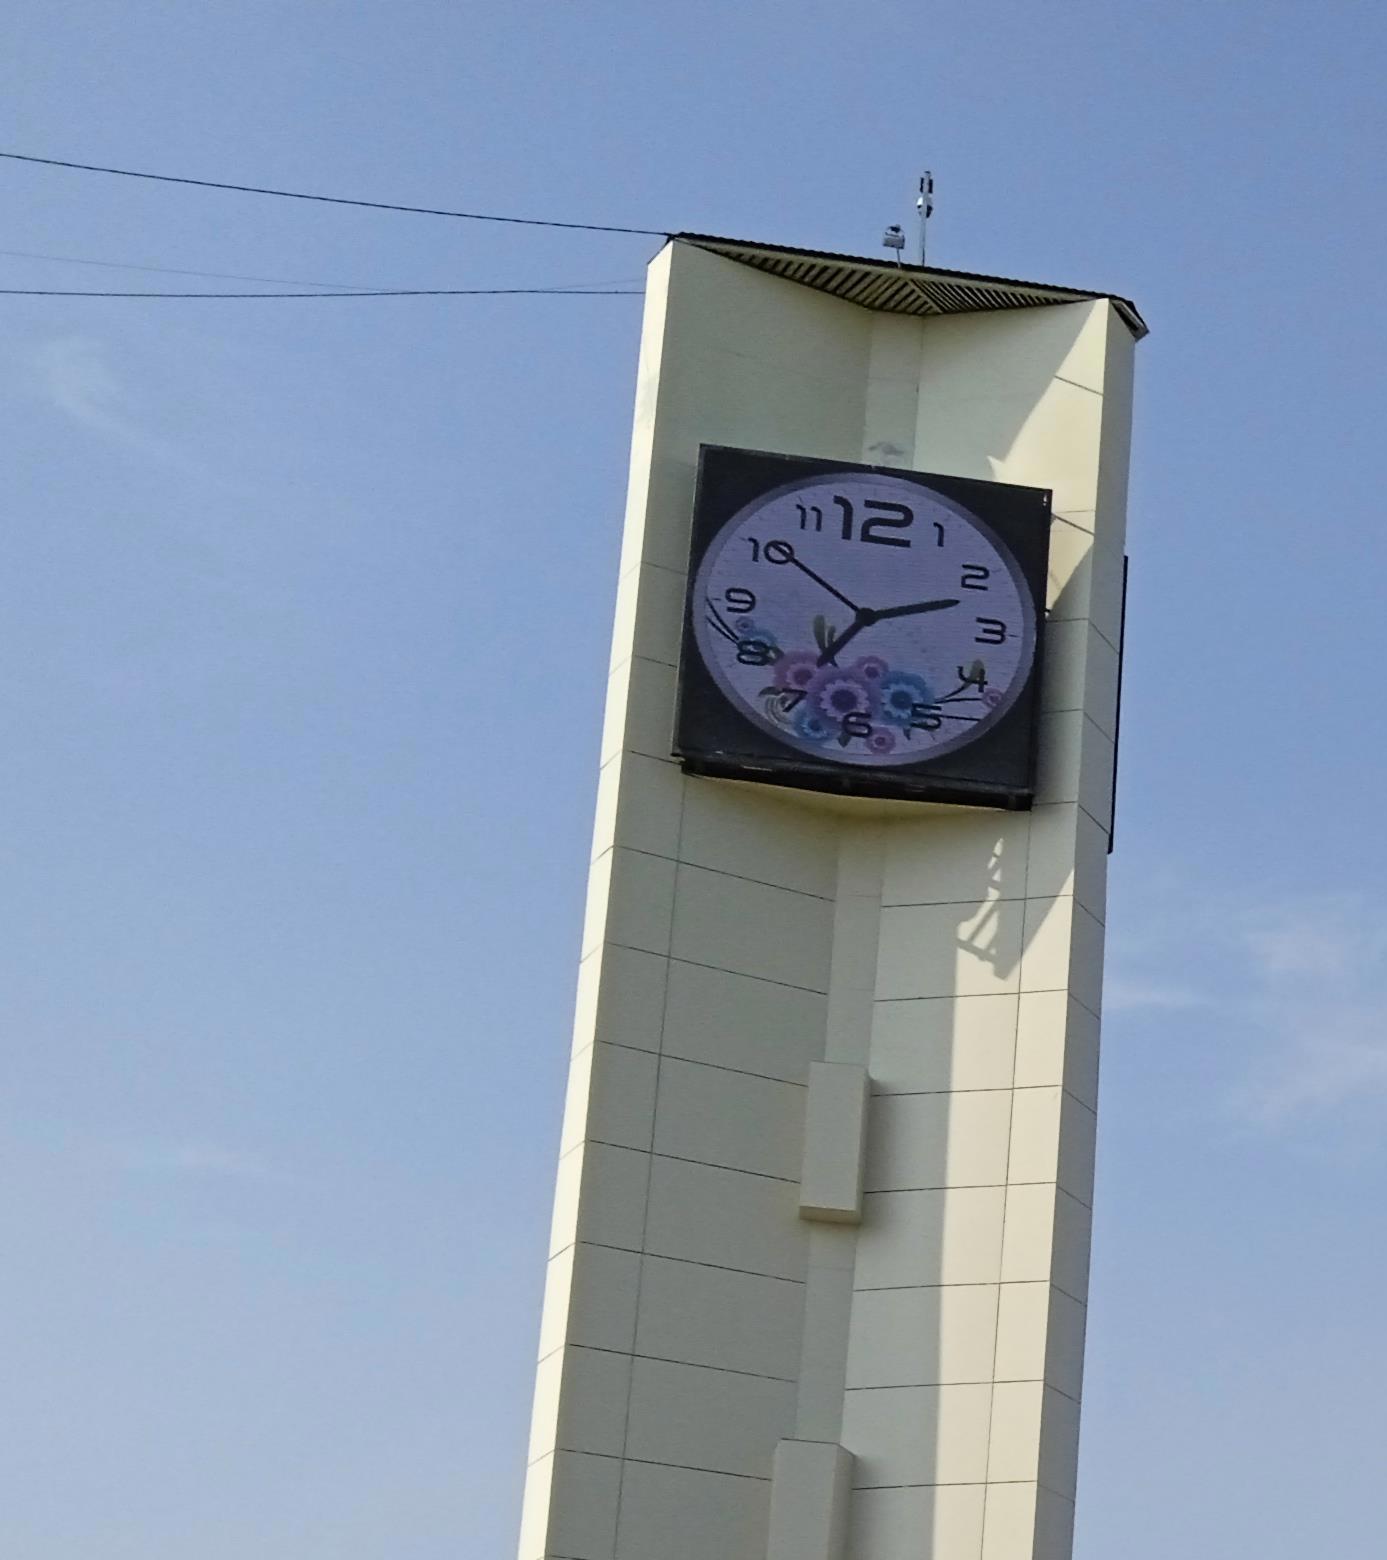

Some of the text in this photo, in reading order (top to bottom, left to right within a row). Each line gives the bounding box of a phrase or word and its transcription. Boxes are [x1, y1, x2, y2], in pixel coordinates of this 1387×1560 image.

[796, 504, 823, 532] 11
[834, 495, 914, 548] 12
[933, 522, 945, 547] 1
[748, 537, 793, 565] 10
[961, 564, 990, 591] 2
[724, 588, 756, 613] 9
[975, 617, 1007, 645] 3
[735, 640, 768, 667] 8
[957, 665, 988, 693] 4
[781, 688, 808, 713] 7
[842, 712, 873, 738] 6
[910, 703, 943, 731] 5
